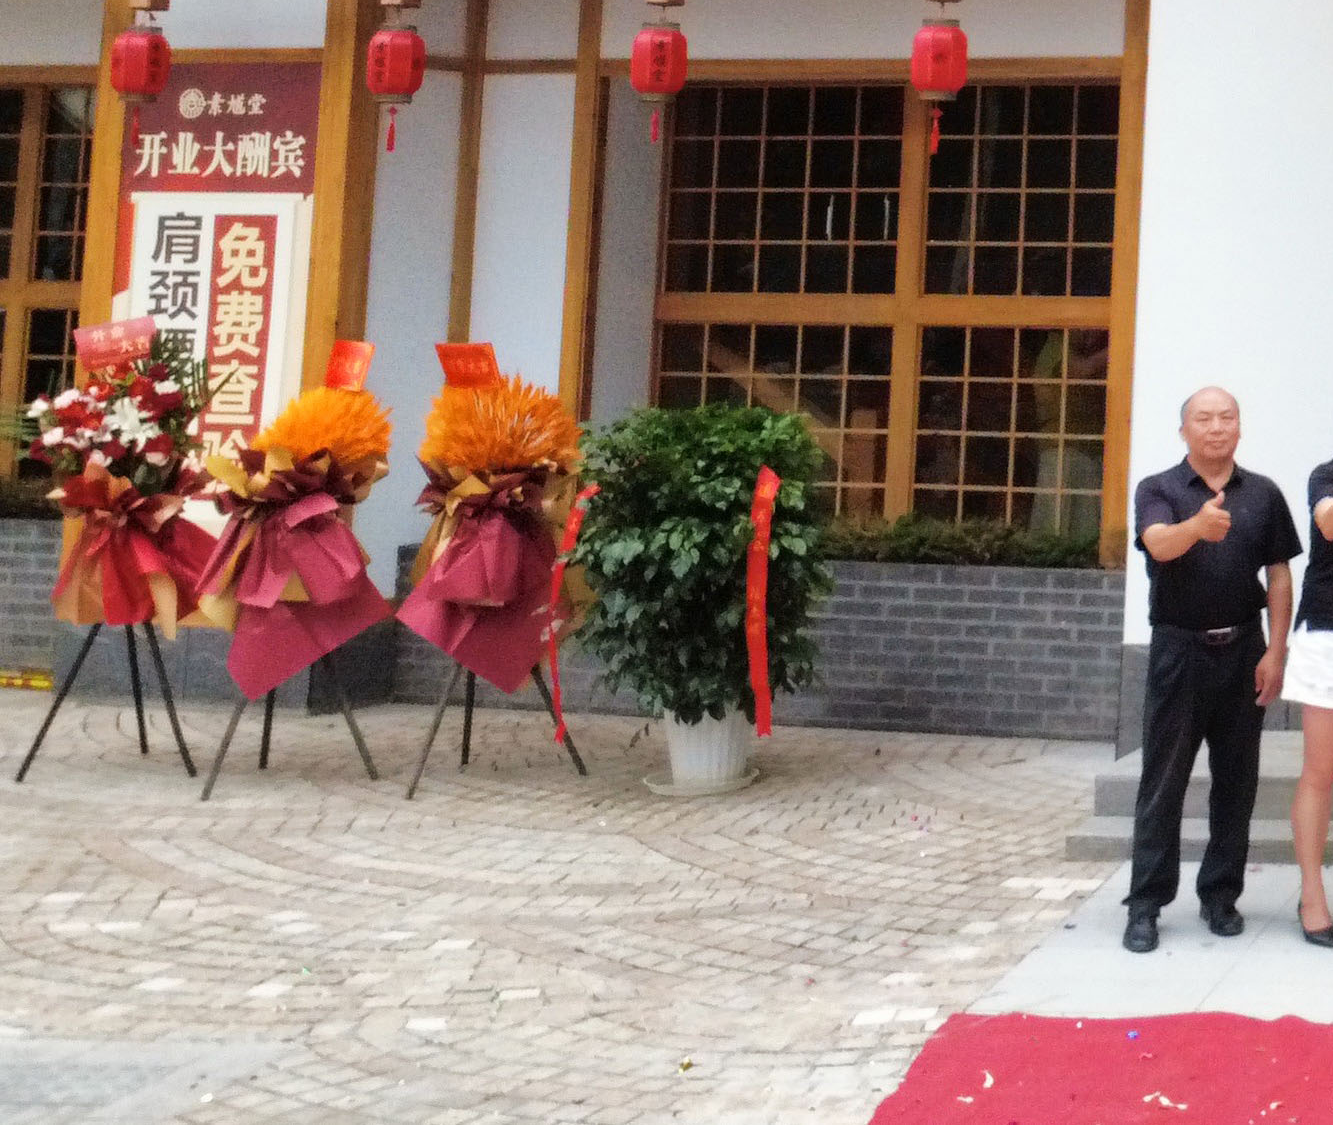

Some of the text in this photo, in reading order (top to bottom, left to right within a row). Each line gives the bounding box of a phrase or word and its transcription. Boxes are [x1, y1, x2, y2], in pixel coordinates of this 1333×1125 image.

[134, 130, 306, 178] 开业大酬宾
